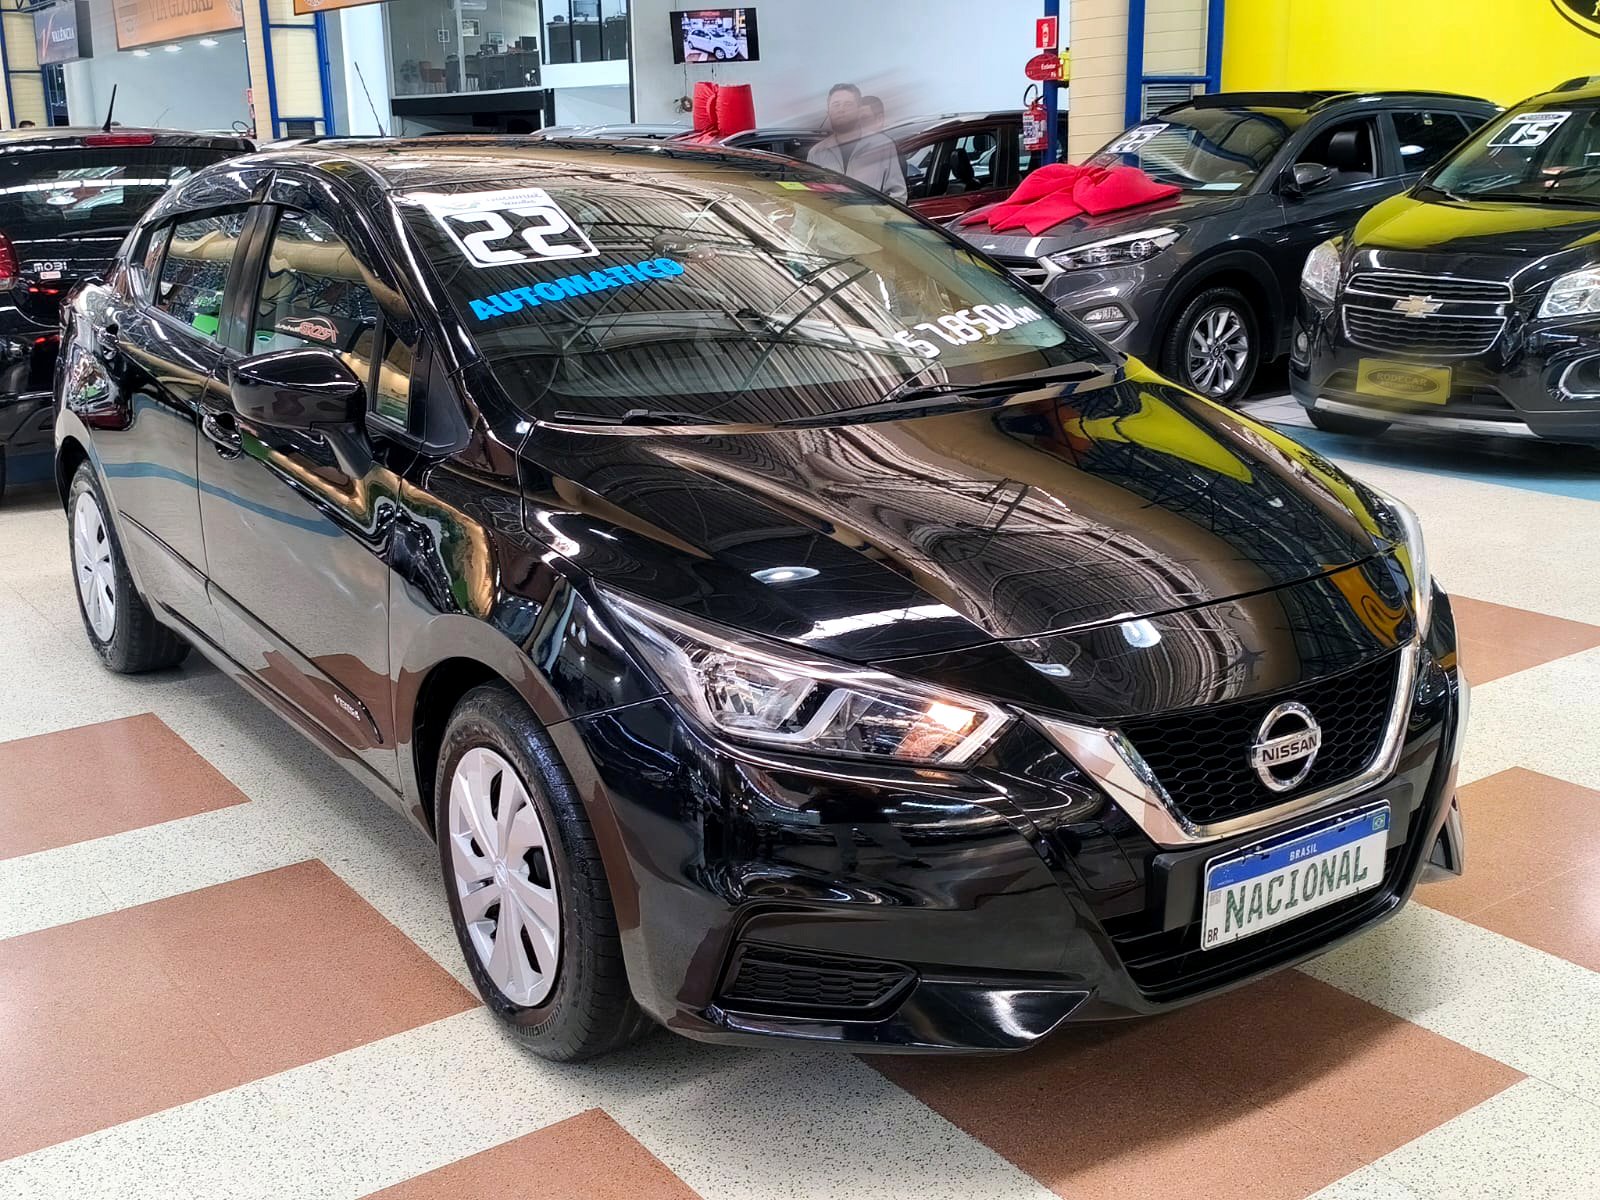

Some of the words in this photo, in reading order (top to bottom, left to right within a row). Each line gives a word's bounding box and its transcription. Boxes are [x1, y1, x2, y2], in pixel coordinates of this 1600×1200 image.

[1508, 123, 1553, 146] 15
[449, 206, 586, 264] 22
[468, 257, 685, 322] AUTOMATICO
[1262, 734, 1318, 762] NISSAN
[1289, 842, 1318, 862] BRASIL
[1224, 845, 1369, 934] NACIONAL
[1207, 927, 1219, 944] BR
